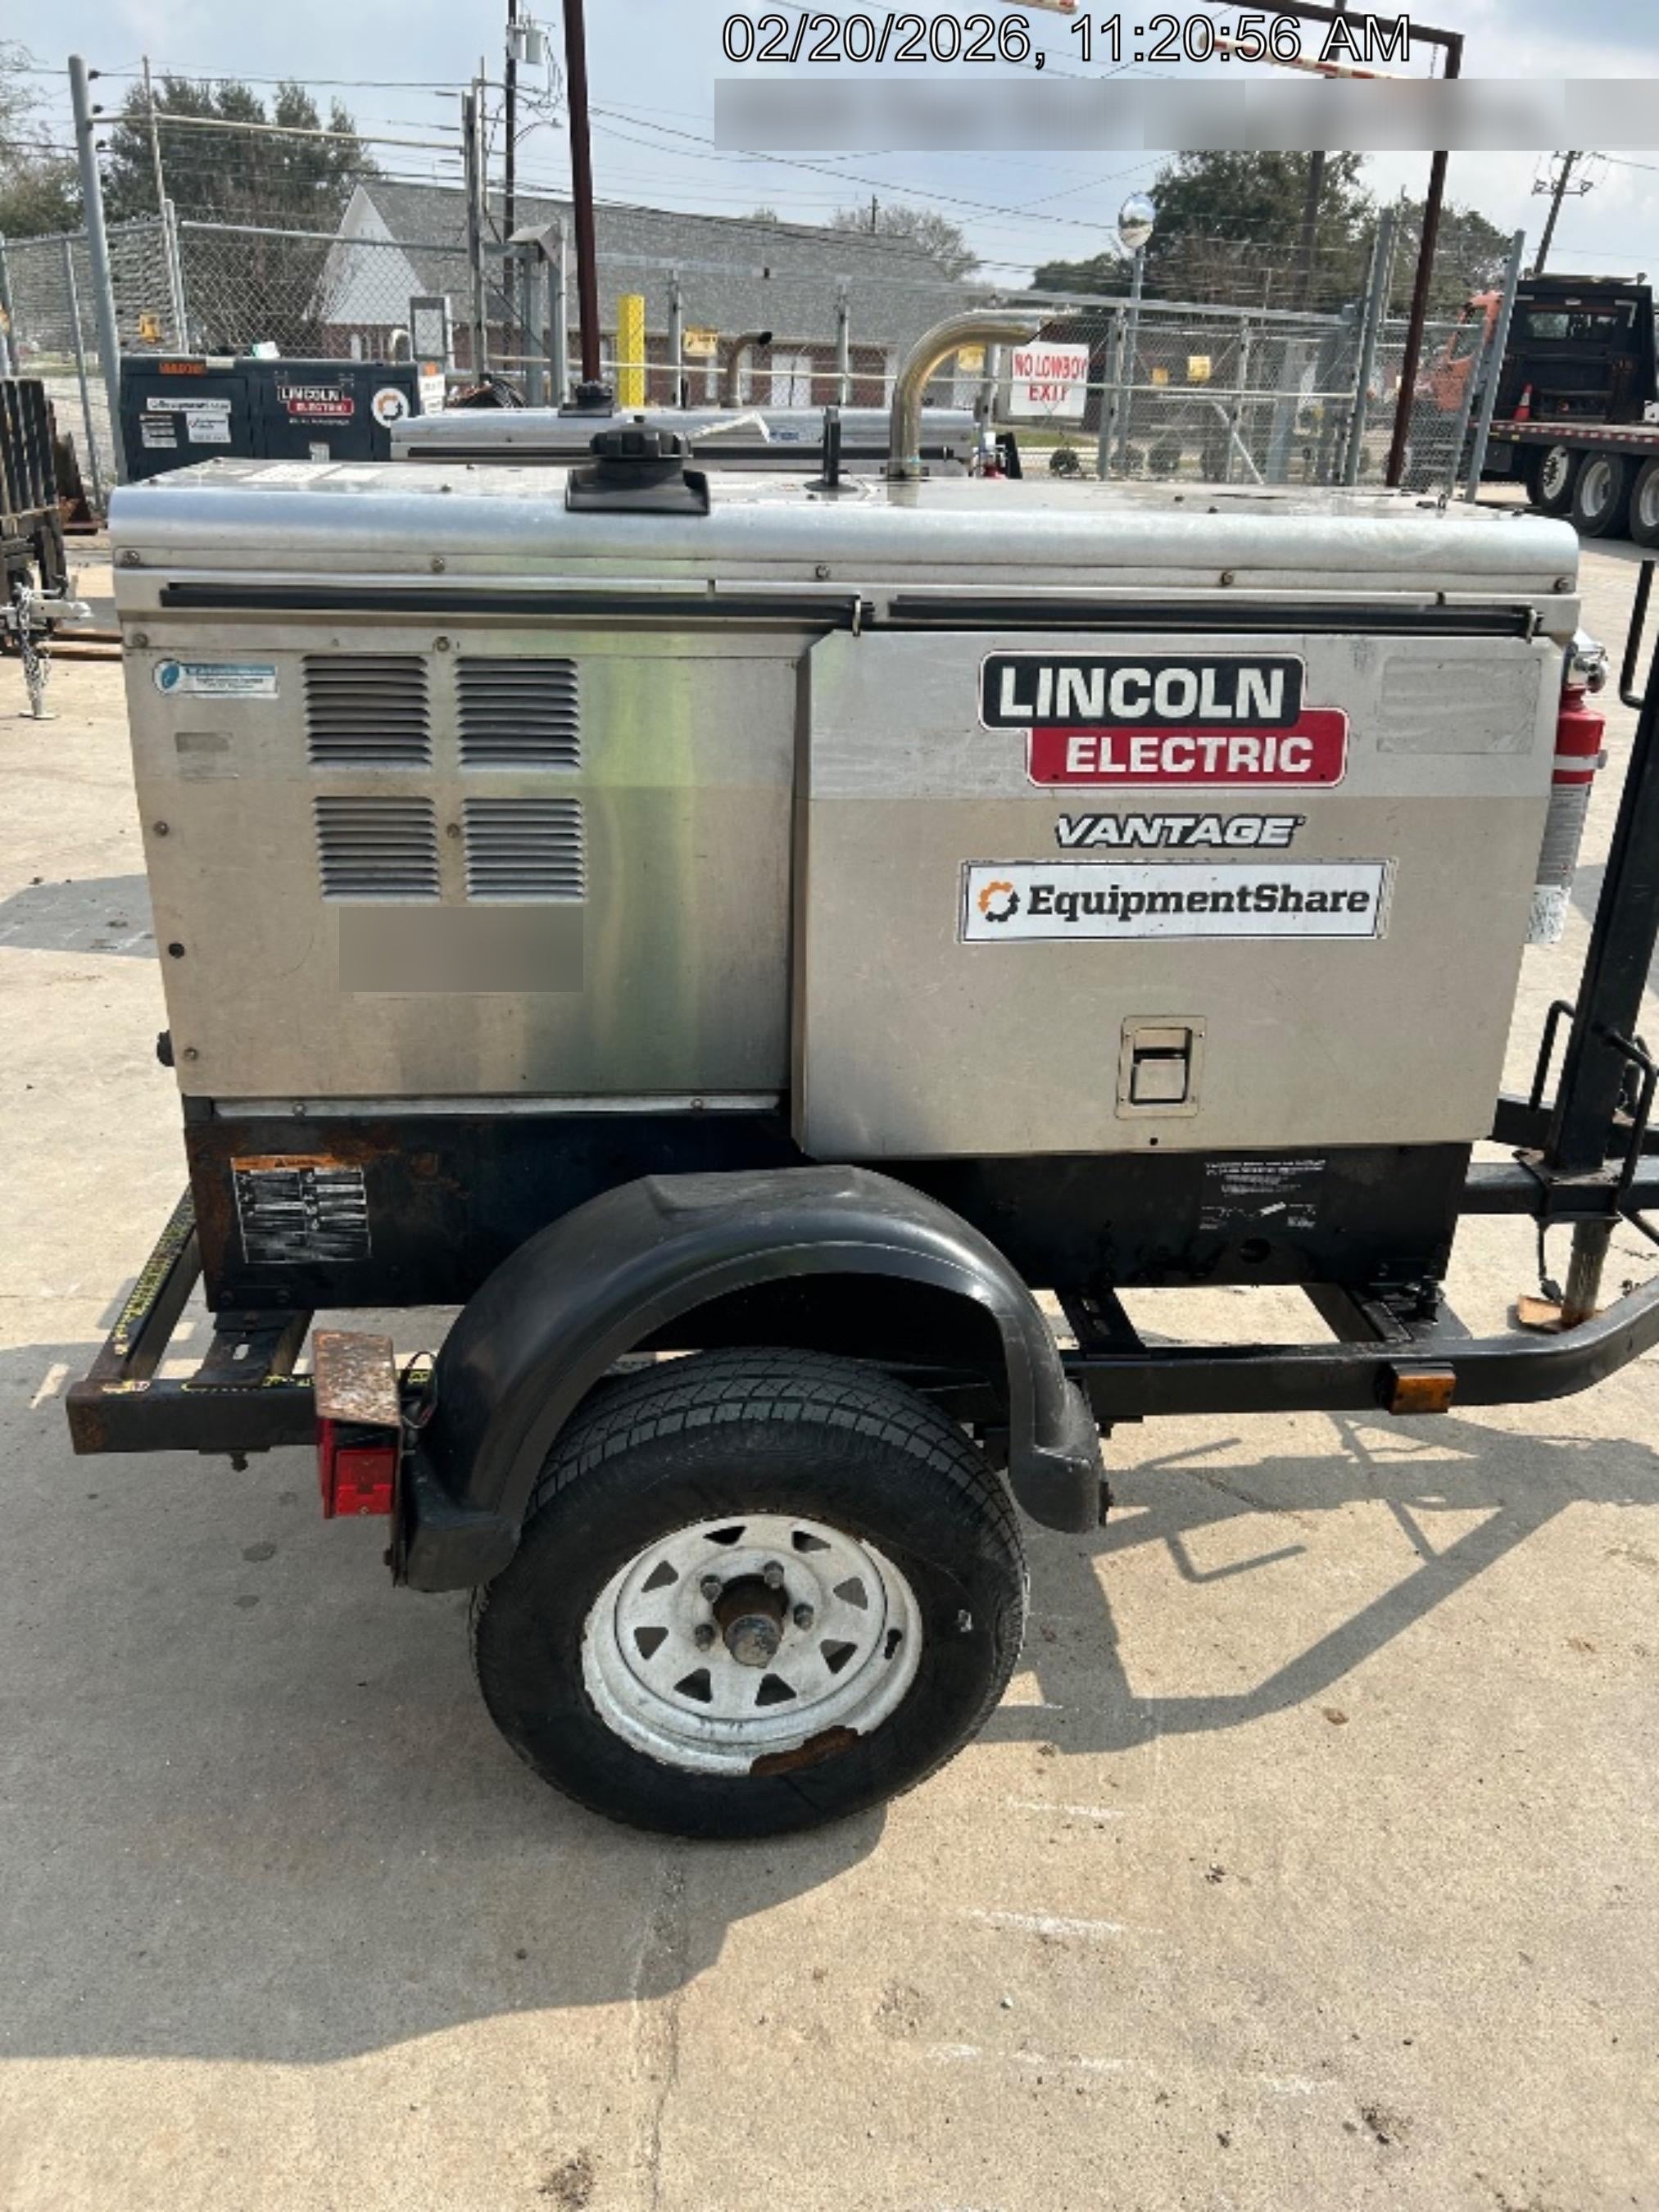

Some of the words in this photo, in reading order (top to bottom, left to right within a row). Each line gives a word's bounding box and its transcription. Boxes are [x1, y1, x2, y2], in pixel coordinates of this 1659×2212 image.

[1015, 353, 1032, 376] NO
[1035, 355, 1087, 379] LOWBOY
[1029, 383, 1068, 401] EXIT
[999, 667, 1285, 719] LINCOLN
[1065, 736, 1314, 773] ELECTRIC
[1056, 814, 1299, 848] VANTAGE
[1027, 883, 1371, 922] EquipmentShare
